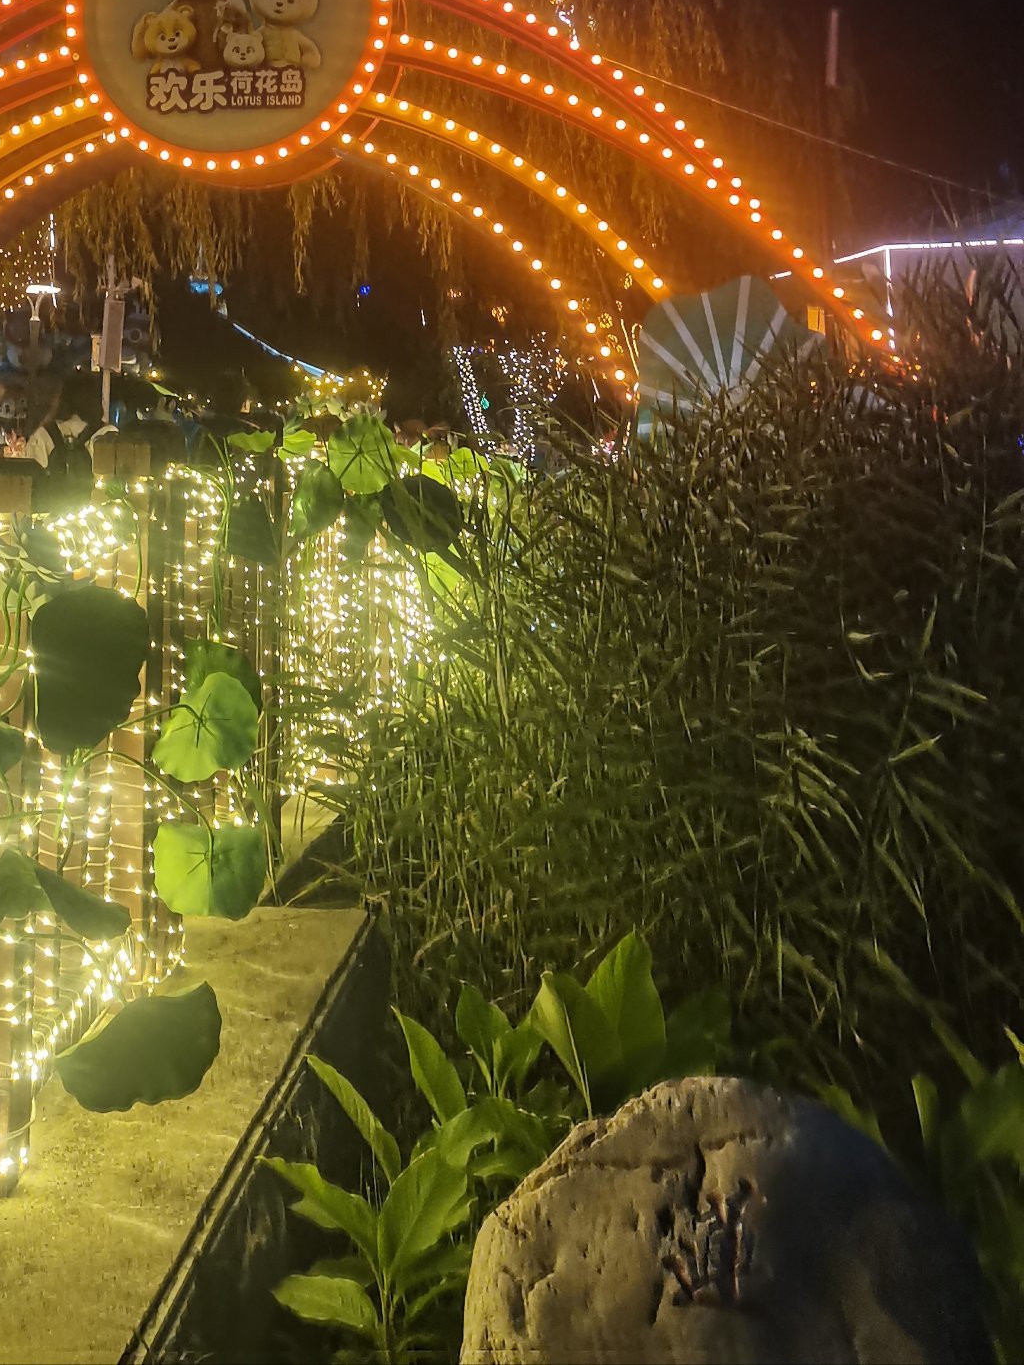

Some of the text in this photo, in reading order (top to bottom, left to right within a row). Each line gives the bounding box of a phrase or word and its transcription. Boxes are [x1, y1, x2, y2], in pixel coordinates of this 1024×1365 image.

[149, 72, 228, 112] 欢乐
[230, 70, 303, 94] 荷花岛
[231, 95, 302, 106] LOTUS ISLAND
